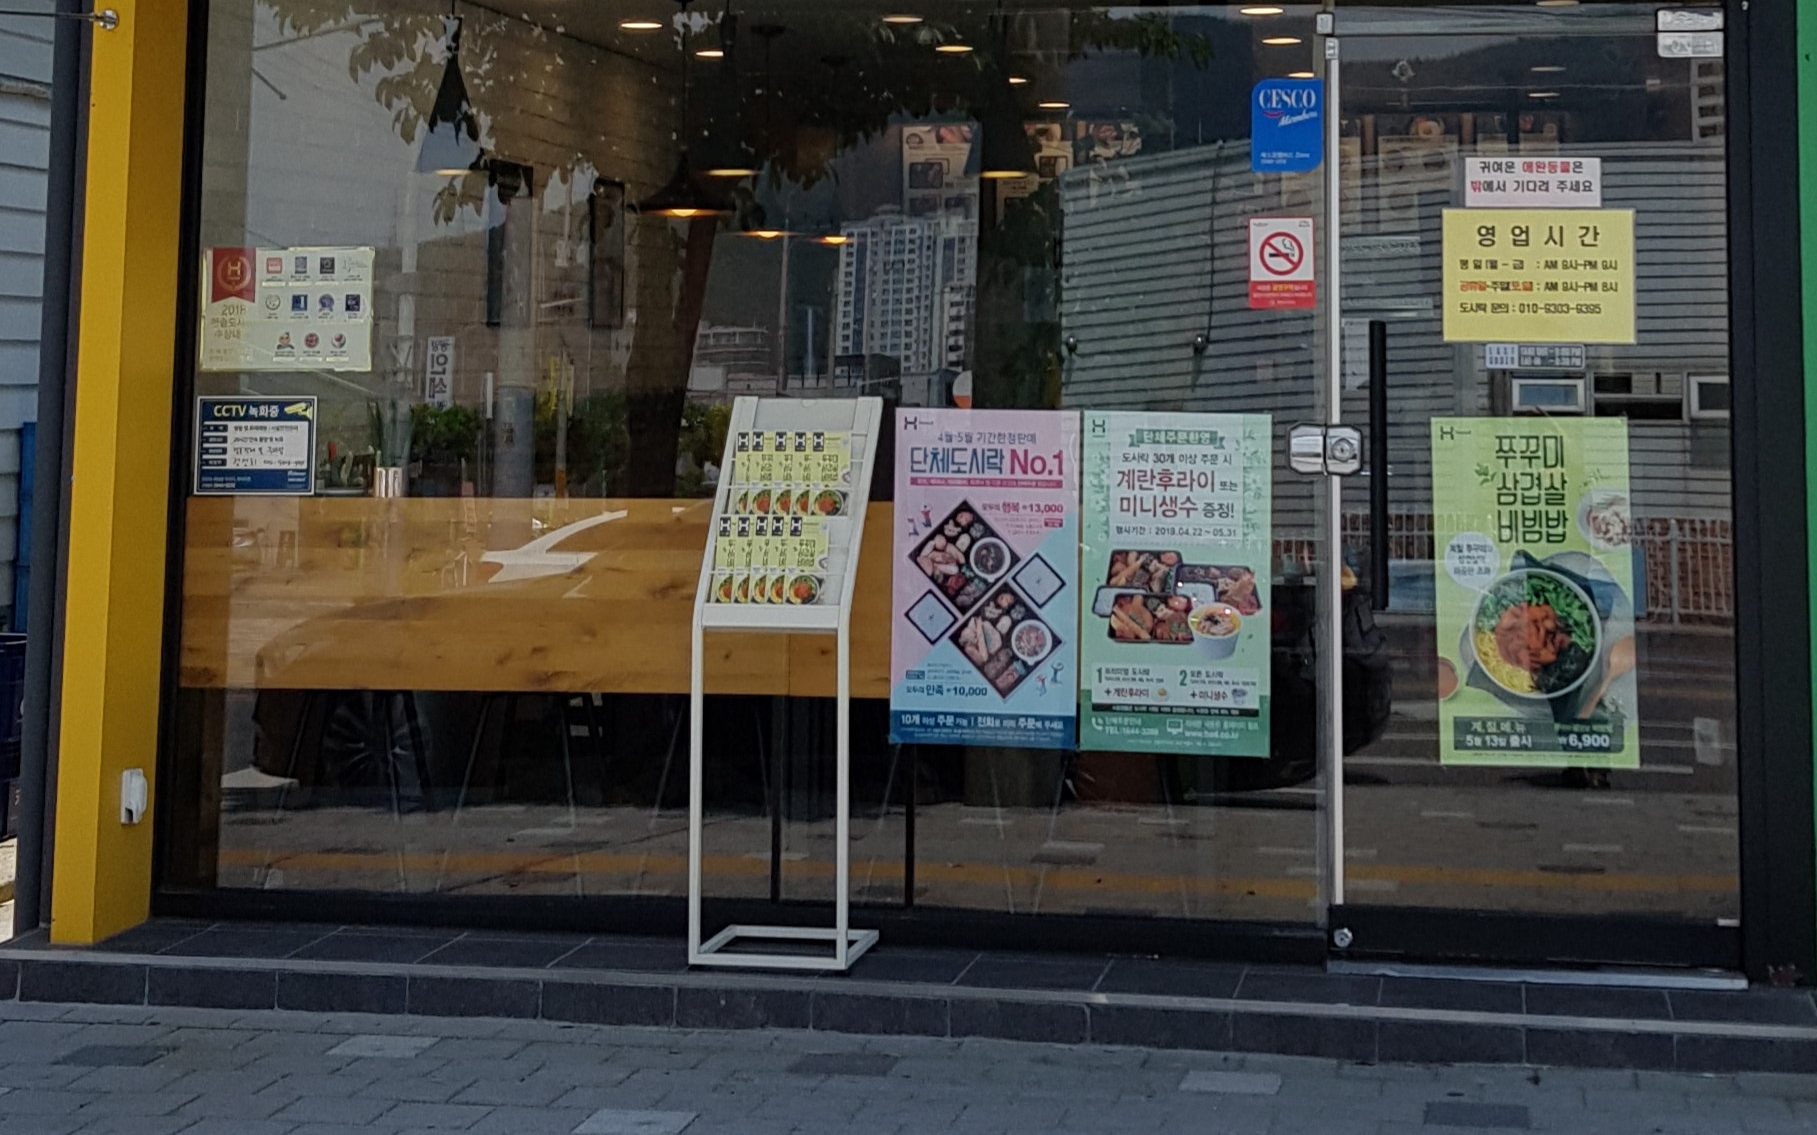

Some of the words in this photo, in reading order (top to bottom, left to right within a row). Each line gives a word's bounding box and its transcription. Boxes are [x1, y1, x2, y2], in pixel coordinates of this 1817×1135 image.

[1259, 88, 1316, 109] CESCO
[1479, 161, 1516, 174] 귀여운
[1522, 161, 1583, 174] 애완동물은
[1471, 180, 1506, 193] 밖에서
[1513, 180, 1549, 193] 기다려
[1556, 180, 1593, 193] 주세요
[213, 405, 247, 417] CCTV
[248, 404, 279, 418] 녹화중
[910, 447, 1005, 475] 단체도시락
[1010, 448, 1063, 476] No.1
[1122, 452, 1149, 464] 도시락
[1153, 453, 1175, 464] 30개
[1178, 453, 1197, 465] 이상
[1200, 454, 1219, 465] 주문
[1222, 454, 1232, 465] 시
[1495, 435, 1565, 469] 쭈꾸미
[1117, 469, 1215, 493] 계란후라이
[1219, 480, 1238, 492] 또는
[1497, 472, 1567, 506] 삼겹살
[1119, 495, 1199, 518] 미니생수
[1202, 502, 1235, 519] 증정!
[1498, 510, 1569, 544] 비빔밥
